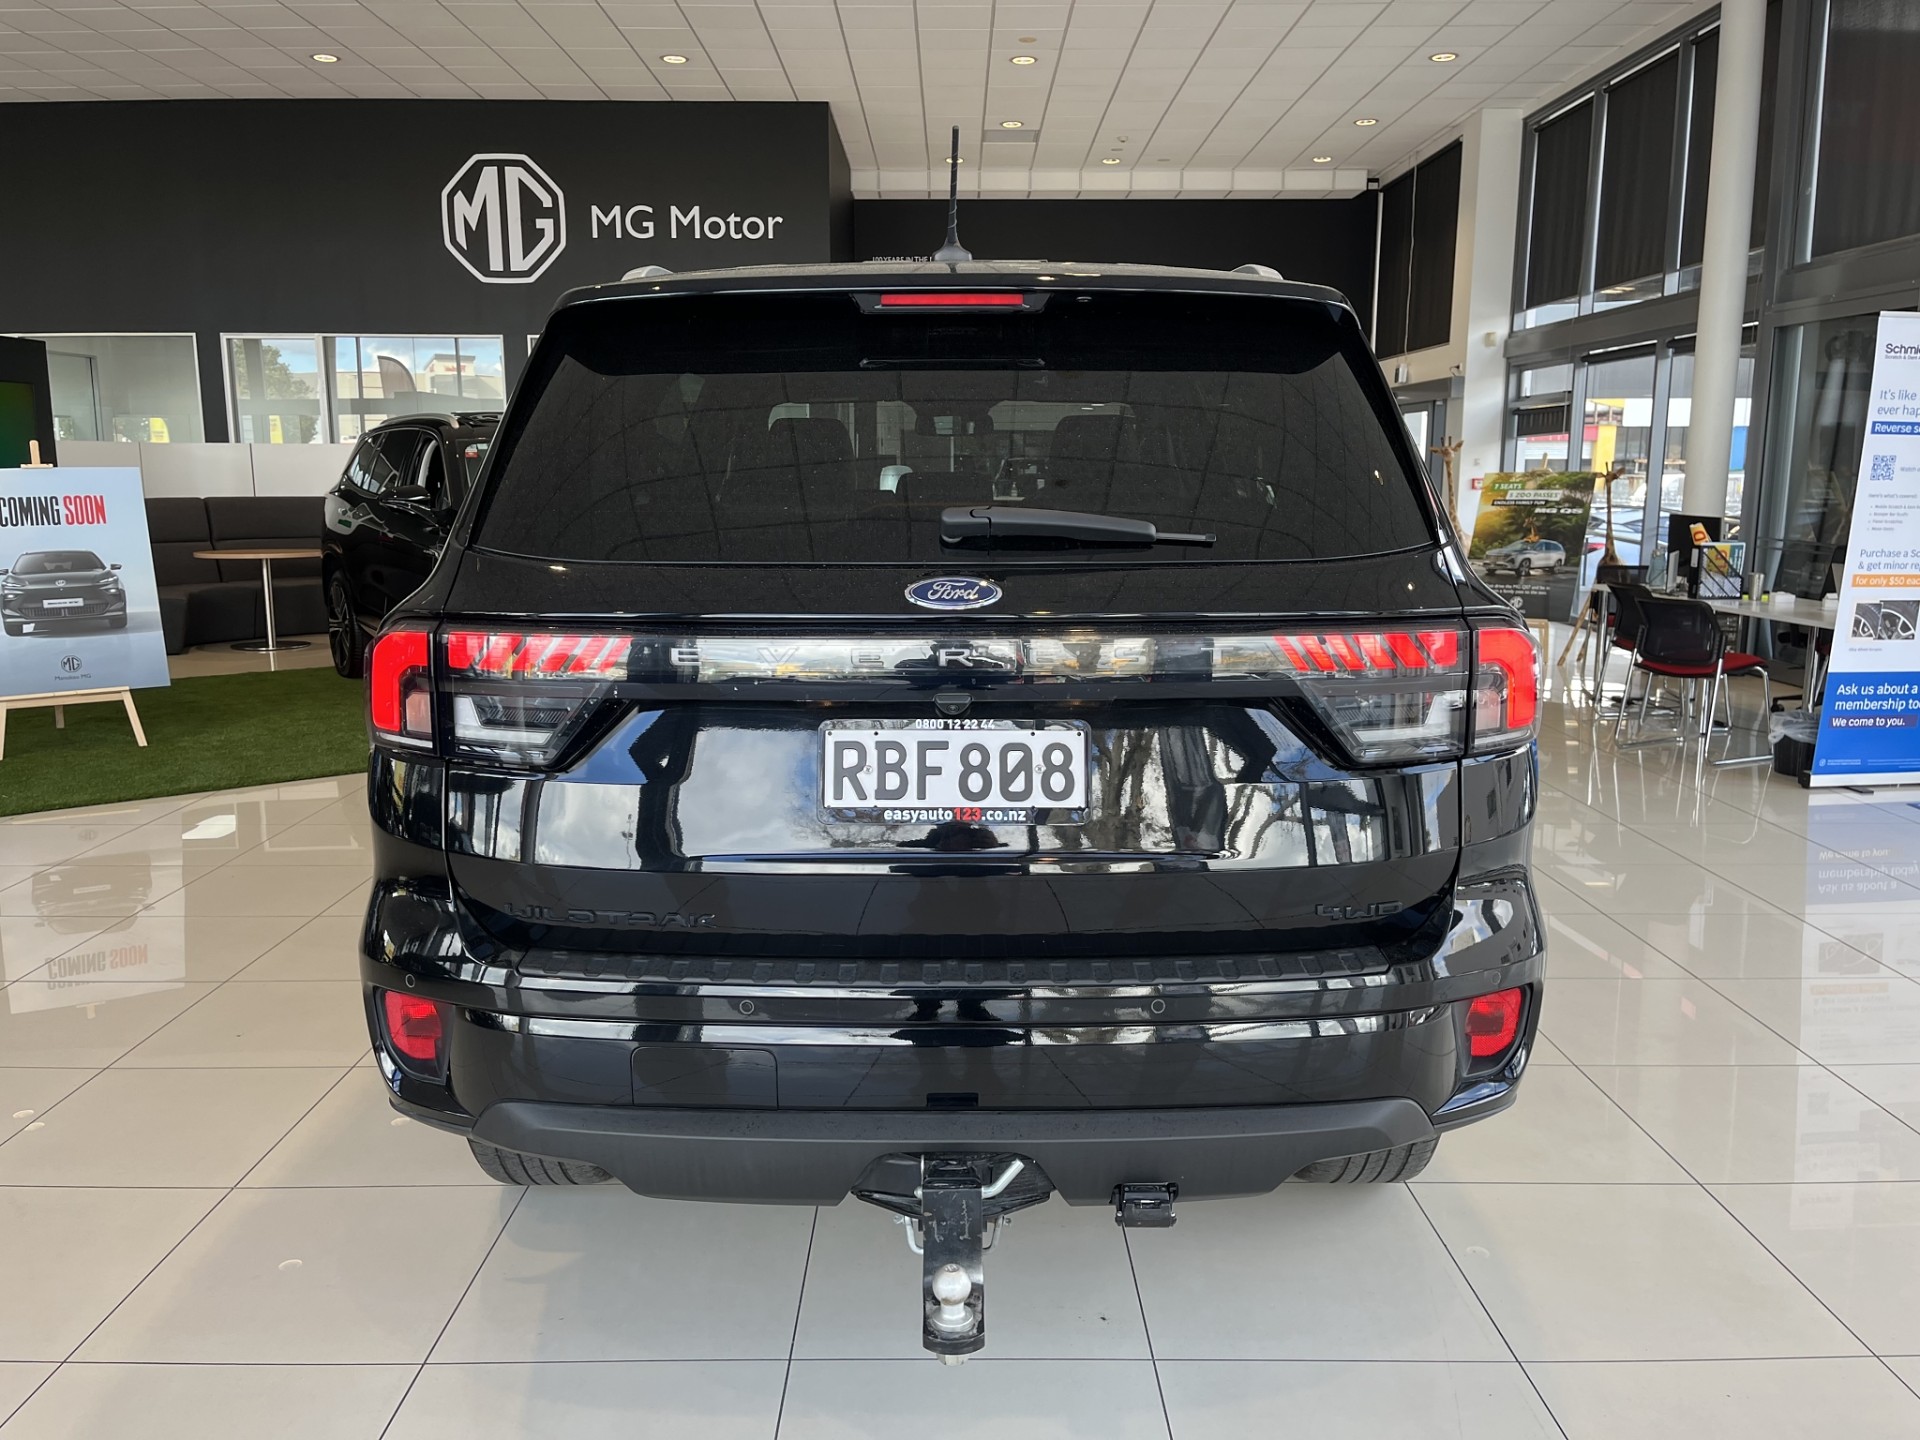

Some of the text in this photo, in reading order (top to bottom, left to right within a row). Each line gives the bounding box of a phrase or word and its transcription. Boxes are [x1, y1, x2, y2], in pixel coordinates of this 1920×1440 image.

[454, 166, 555, 272] MG
[591, 205, 783, 239] MG Motor
[1880, 389, 1917, 401] It's like
[1877, 406, 1900, 415] ever
[1875, 423, 1912, 433] Reverse
[1515, 491, 1532, 499] ZOO
[0, 495, 107, 527] COMING SOON
[1860, 548, 1902, 558] Purchase
[1902, 550, 1909, 558] a
[1857, 561, 1865, 570] &
[1866, 562, 1881, 572] get
[1883, 560, 1909, 570] minor
[1856, 576, 1868, 585] for
[1869, 576, 1887, 587] only
[1889, 576, 1905, 586] $50
[928, 581, 980, 600] Ford
[62, 656, 81, 671] MG
[1837, 682, 1918, 695] Ask us about a
[1834, 697, 1906, 712] membership
[915, 719, 995, 730] 0800 12 22 44
[1832, 716, 1906, 728] We come to you.
[884, 808, 1026, 821] easyauto123.co.nz
